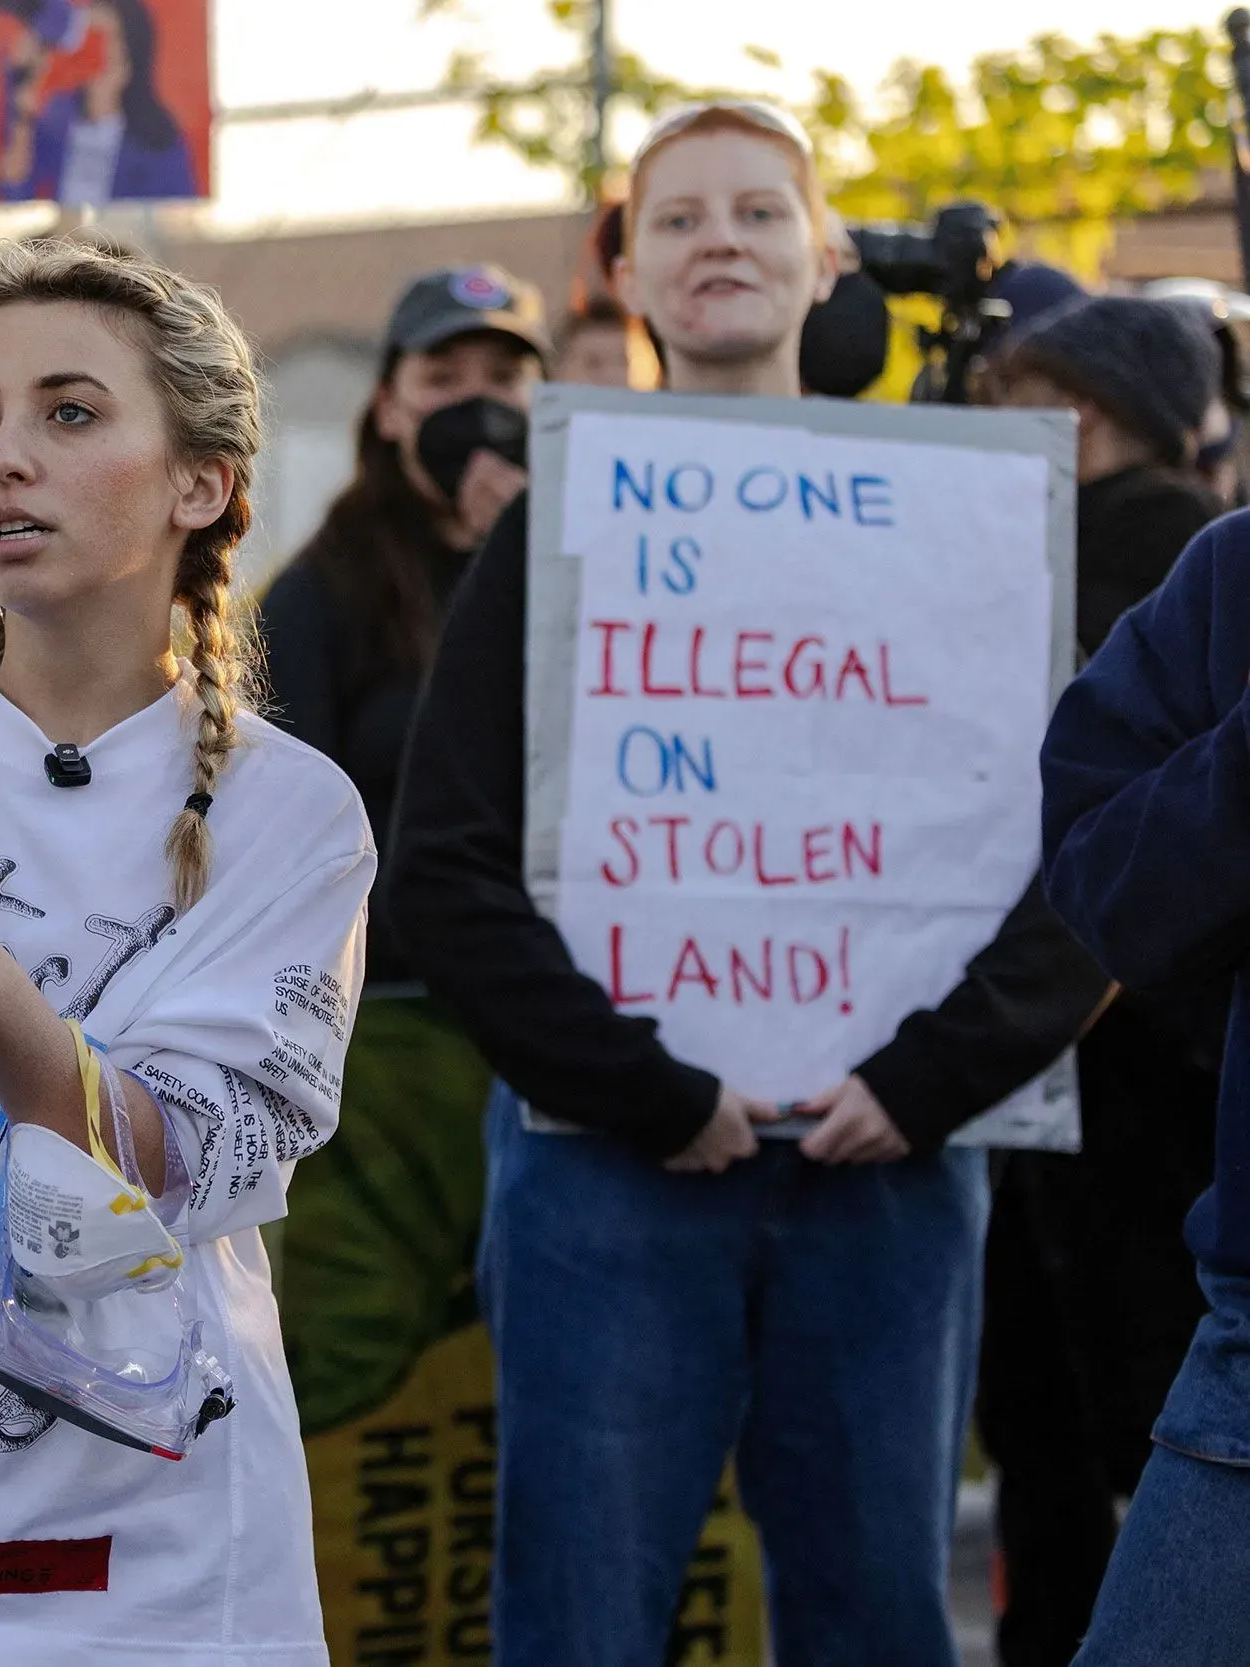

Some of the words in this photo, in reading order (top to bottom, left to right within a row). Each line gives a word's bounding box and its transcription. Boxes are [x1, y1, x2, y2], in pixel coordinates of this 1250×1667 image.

[611, 456, 714, 514] NO
[738, 465, 896, 527] ONE
[636, 534, 702, 597] IS
[590, 618, 929, 706] ILLEGAL
[617, 725, 717, 797] ON
[600, 815, 883, 888] STOLEN
[609, 924, 854, 1015] LAND!
[273, 975, 310, 992] GUISE
[310, 984, 321, 997] OF
[275, 986, 310, 1012] SYSTEM
[274, 999, 288, 1017] US.
[271, 1045, 289, 1064] AND
[258, 1057, 290, 1084] SAFETY.
[144, 1063, 187, 1093] SAFETY
[186, 1086, 225, 1122] COMES
[217, 1063, 240, 1115] OTECTS
[243, 1113, 256, 1127] IS
[287, 1110, 306, 1141] WHO
[228, 1175, 243, 1201] NOT
[244, 1170, 263, 1192] THE
